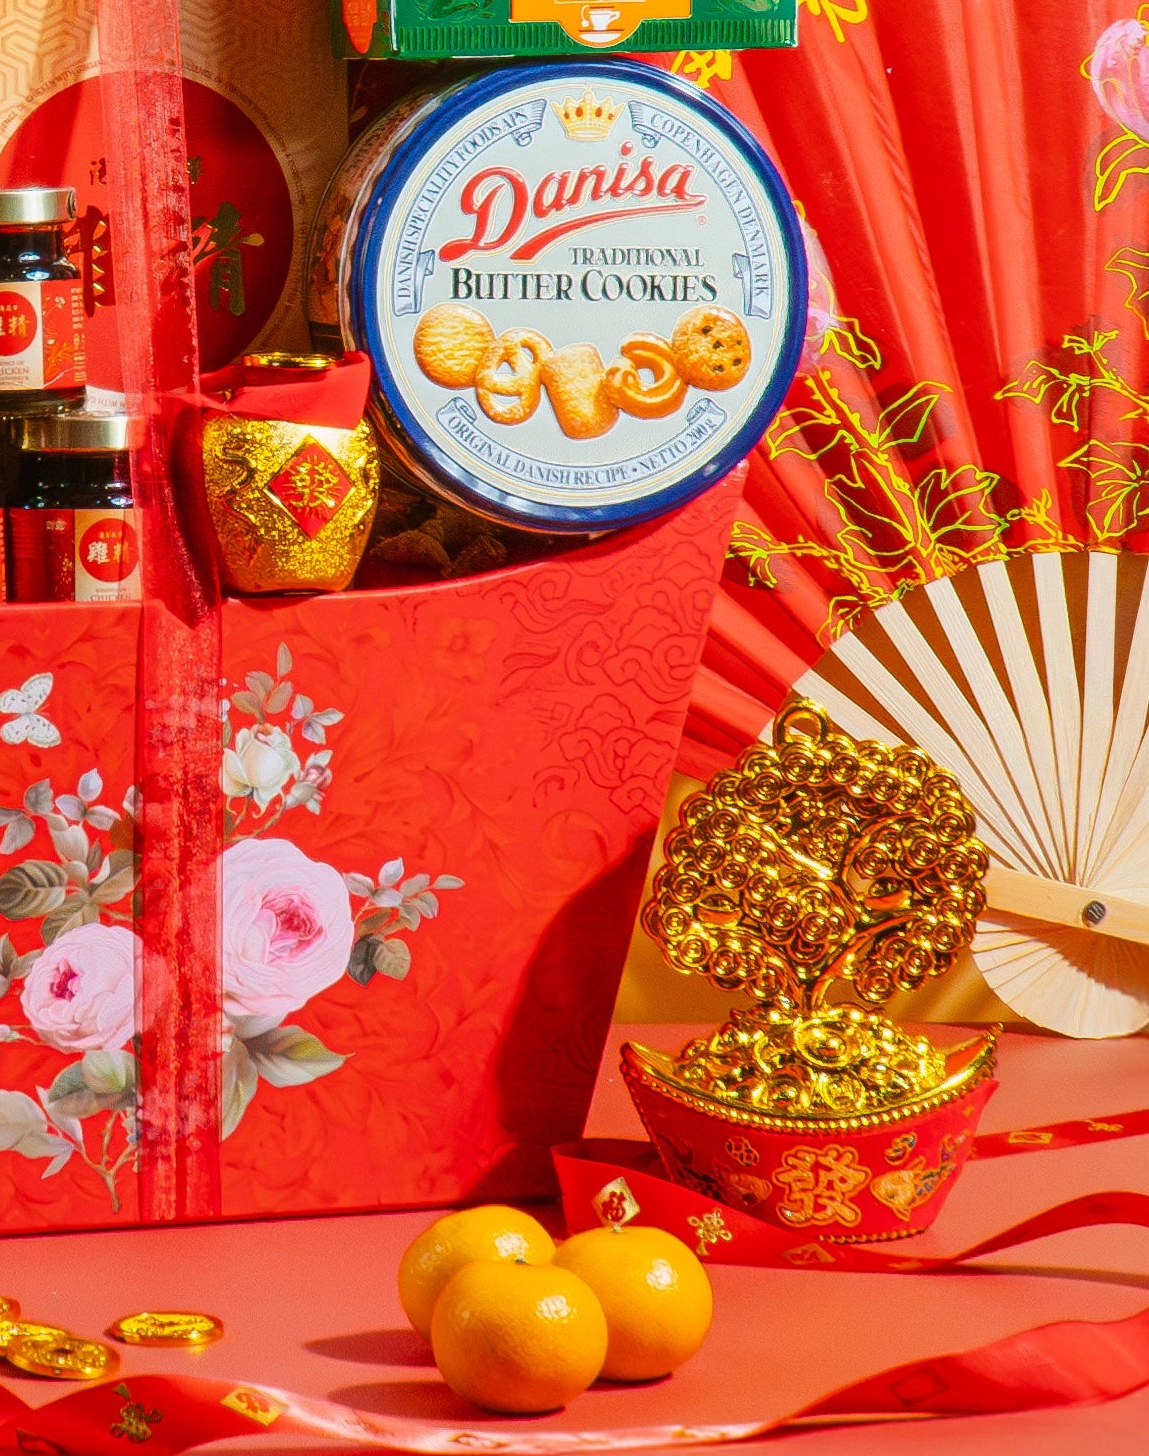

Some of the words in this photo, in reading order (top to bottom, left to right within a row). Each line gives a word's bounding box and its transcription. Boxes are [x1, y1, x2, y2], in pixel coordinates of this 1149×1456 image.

[456, 123, 502, 163] FOODS
[404, 152, 459, 239] SPECIALITY
[438, 140, 708, 263] Danisa
[649, 112, 741, 205] COPENHAGEN
[737, 206, 770, 297] DENMARK
[396, 240, 420, 298] DANISH
[450, 267, 573, 302] BUTTER
[581, 269, 719, 303] COOKIES
[568, 246, 705, 268] TRADITIONAL
[446, 415, 512, 474] ORIGINAL
[509, 461, 570, 485] DANISH
[570, 466, 630, 486] RECIPE
[639, 441, 689, 472] NETTO
